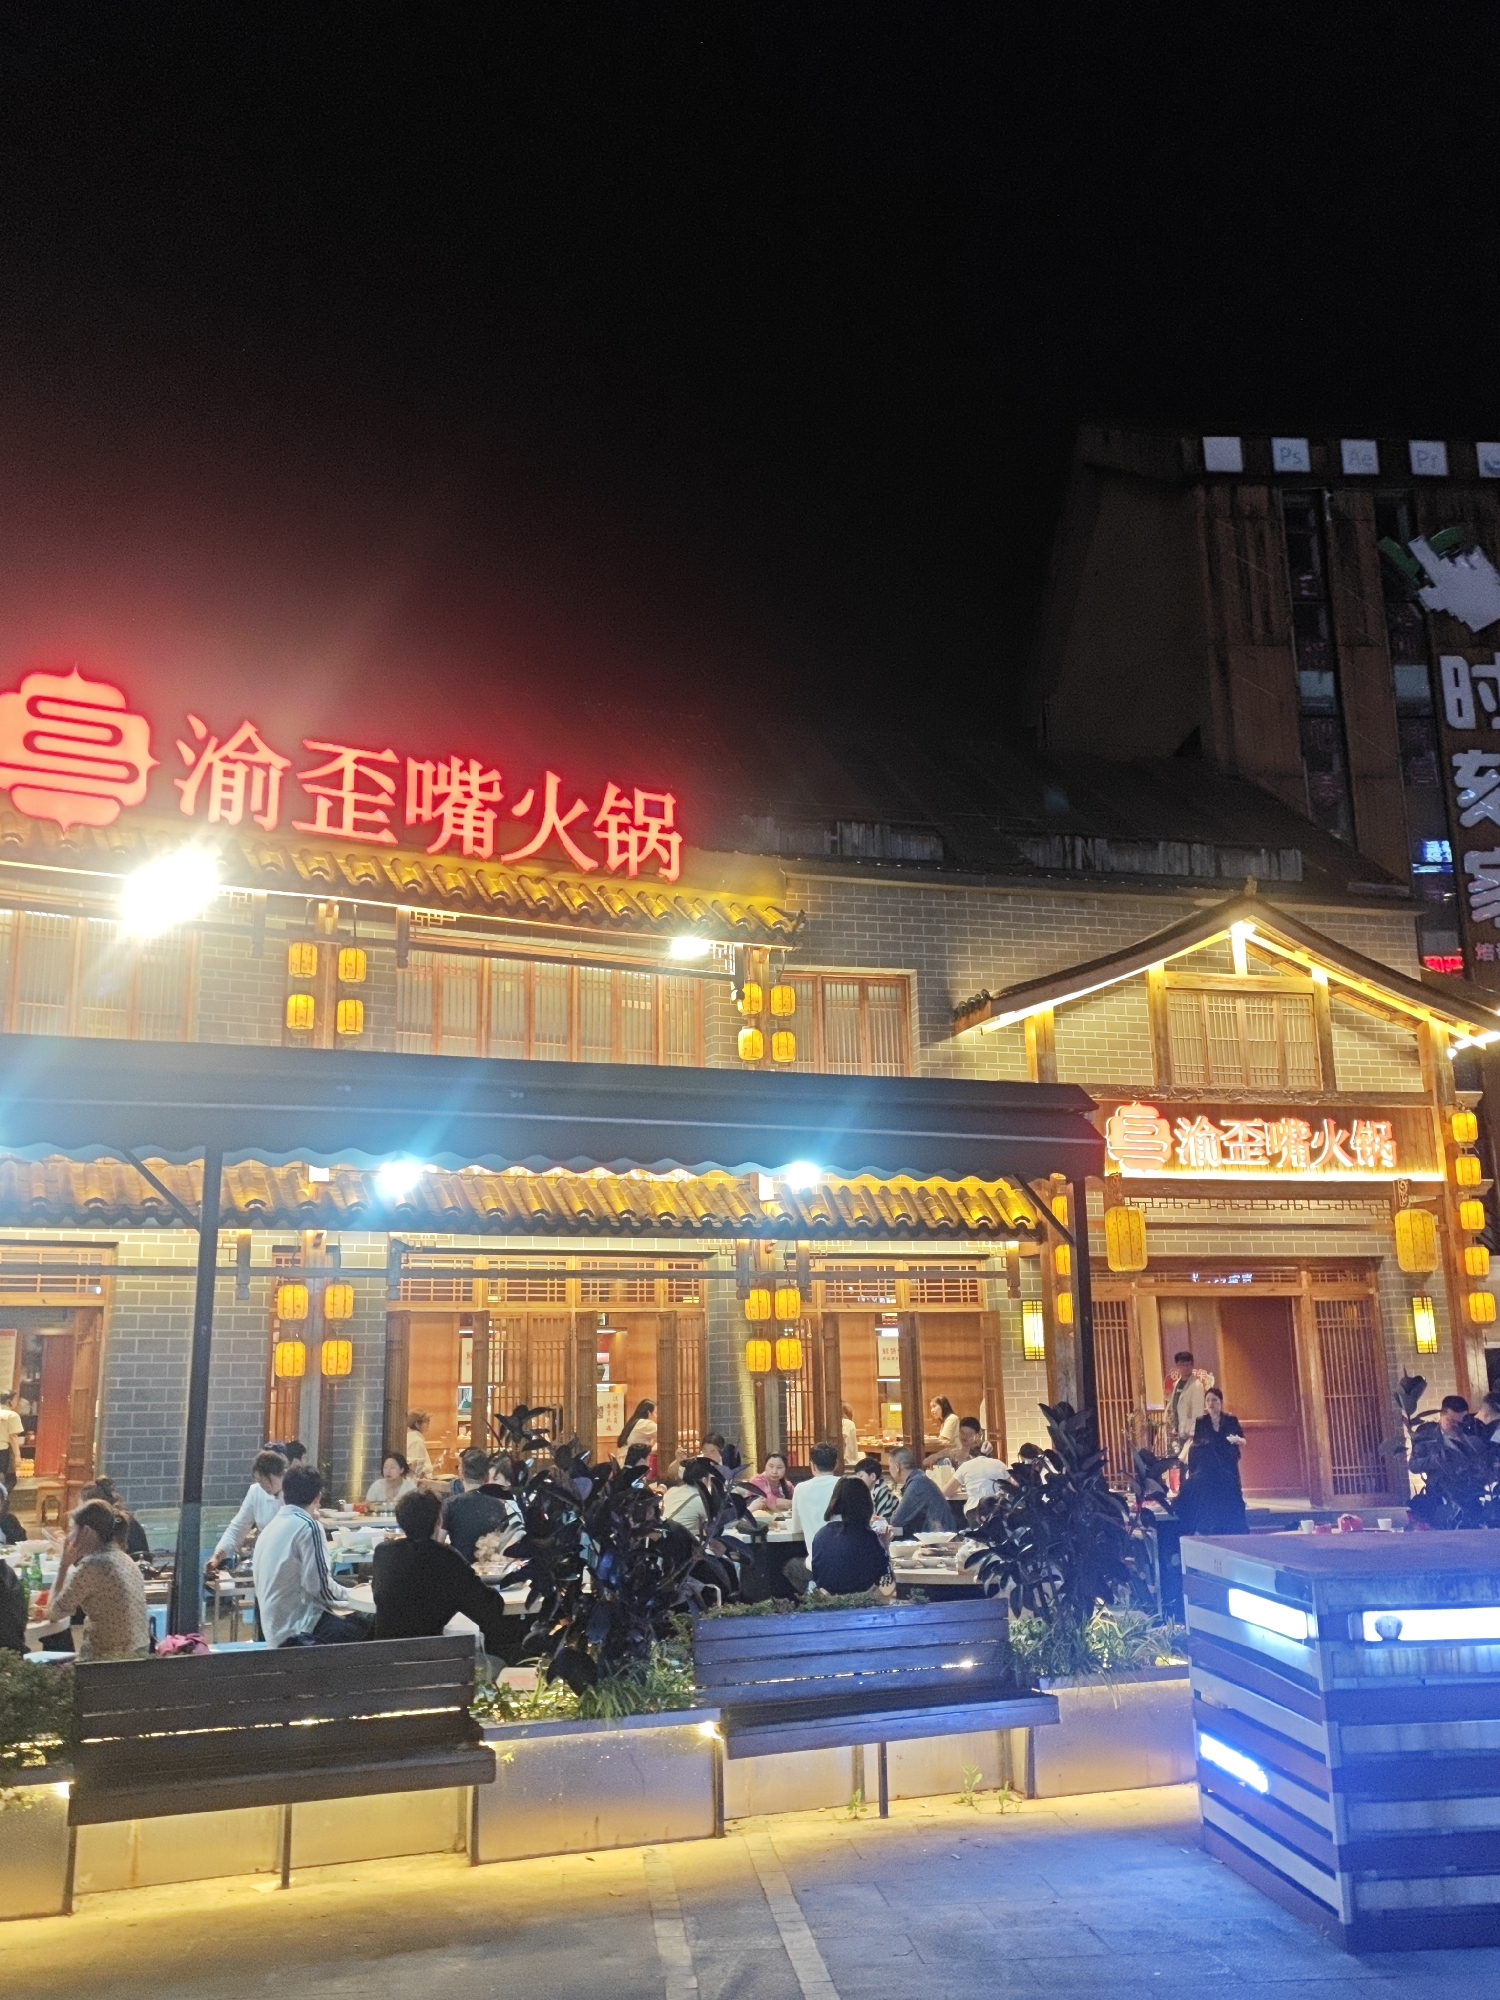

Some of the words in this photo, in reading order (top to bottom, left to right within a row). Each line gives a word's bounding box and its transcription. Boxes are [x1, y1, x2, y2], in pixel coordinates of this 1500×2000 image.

[1279, 446, 1304, 466] Ps
[173, 712, 684, 884] 渝歪嘴火锅
[1174, 1115, 1397, 1169] 渝歪嘴火锅
